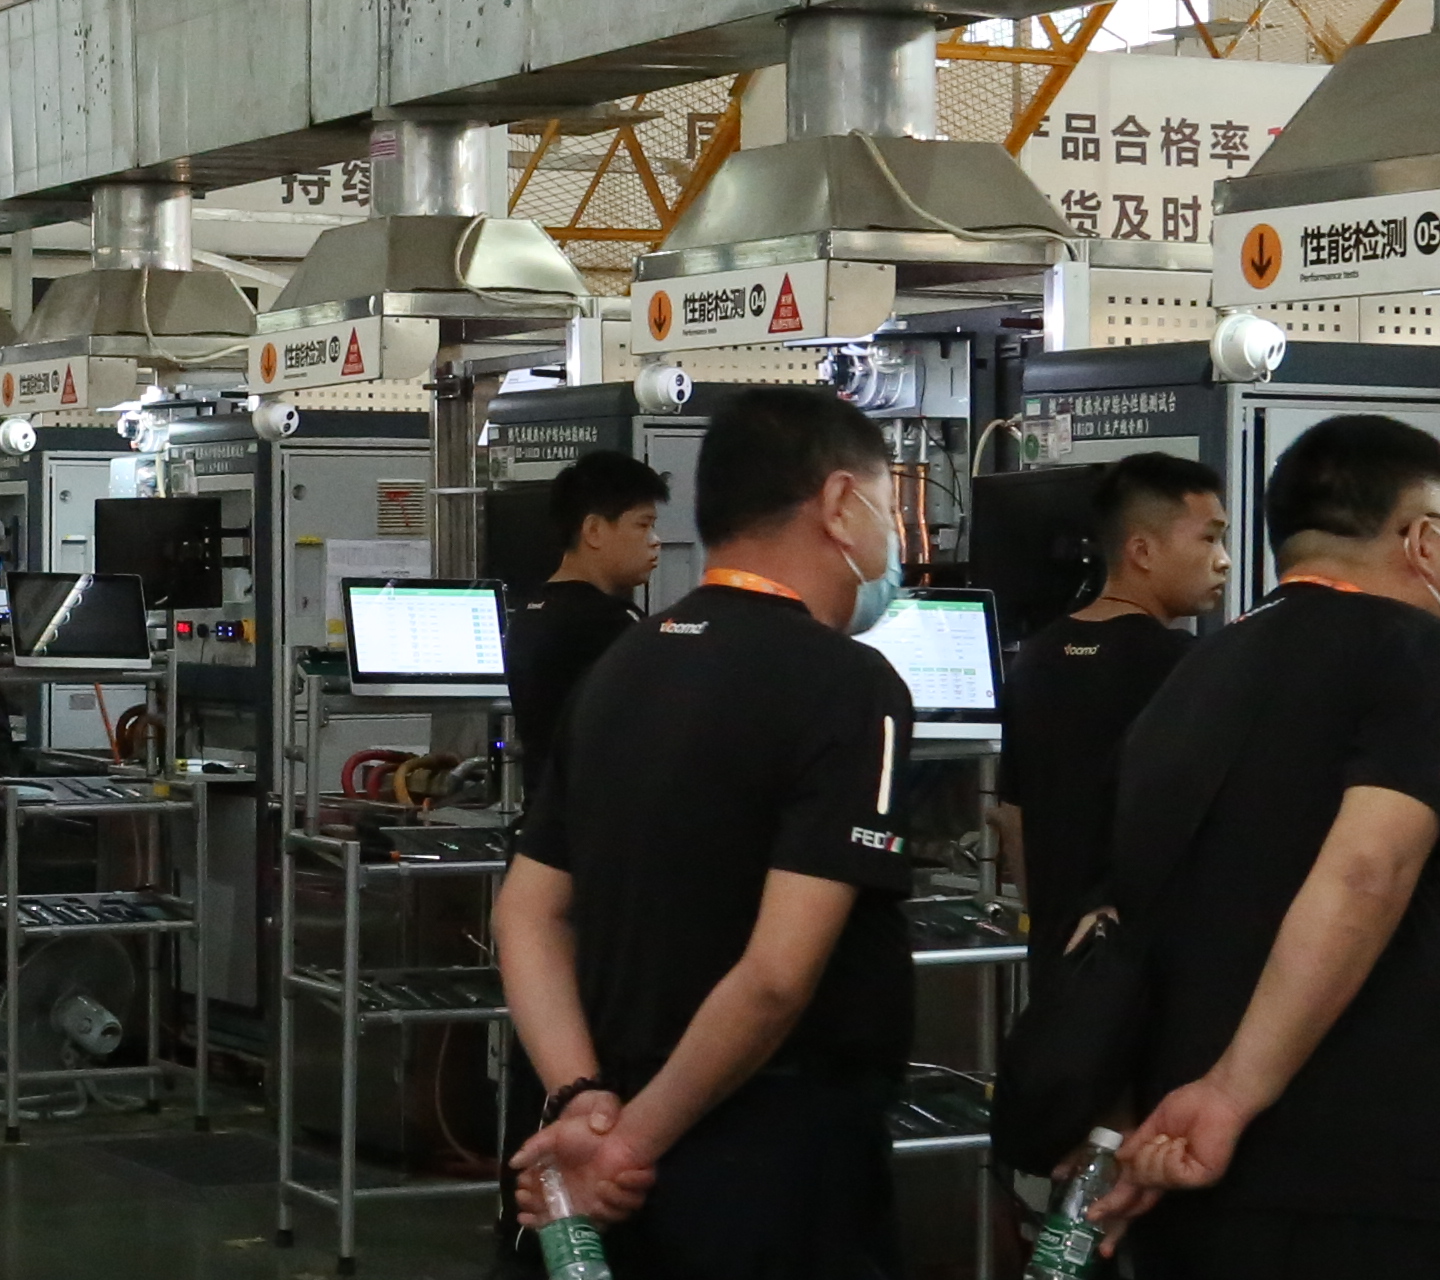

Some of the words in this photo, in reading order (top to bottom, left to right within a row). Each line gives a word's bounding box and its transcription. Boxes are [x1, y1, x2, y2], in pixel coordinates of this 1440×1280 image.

[1033, 113, 1282, 169] 品合格率
[1046, 189, 1213, 243] 货及时
[1301, 217, 1407, 268] 性能检测
[1416, 221, 1440, 246] 05
[683, 287, 746, 325] 性能检测
[751, 291, 766, 309] 04
